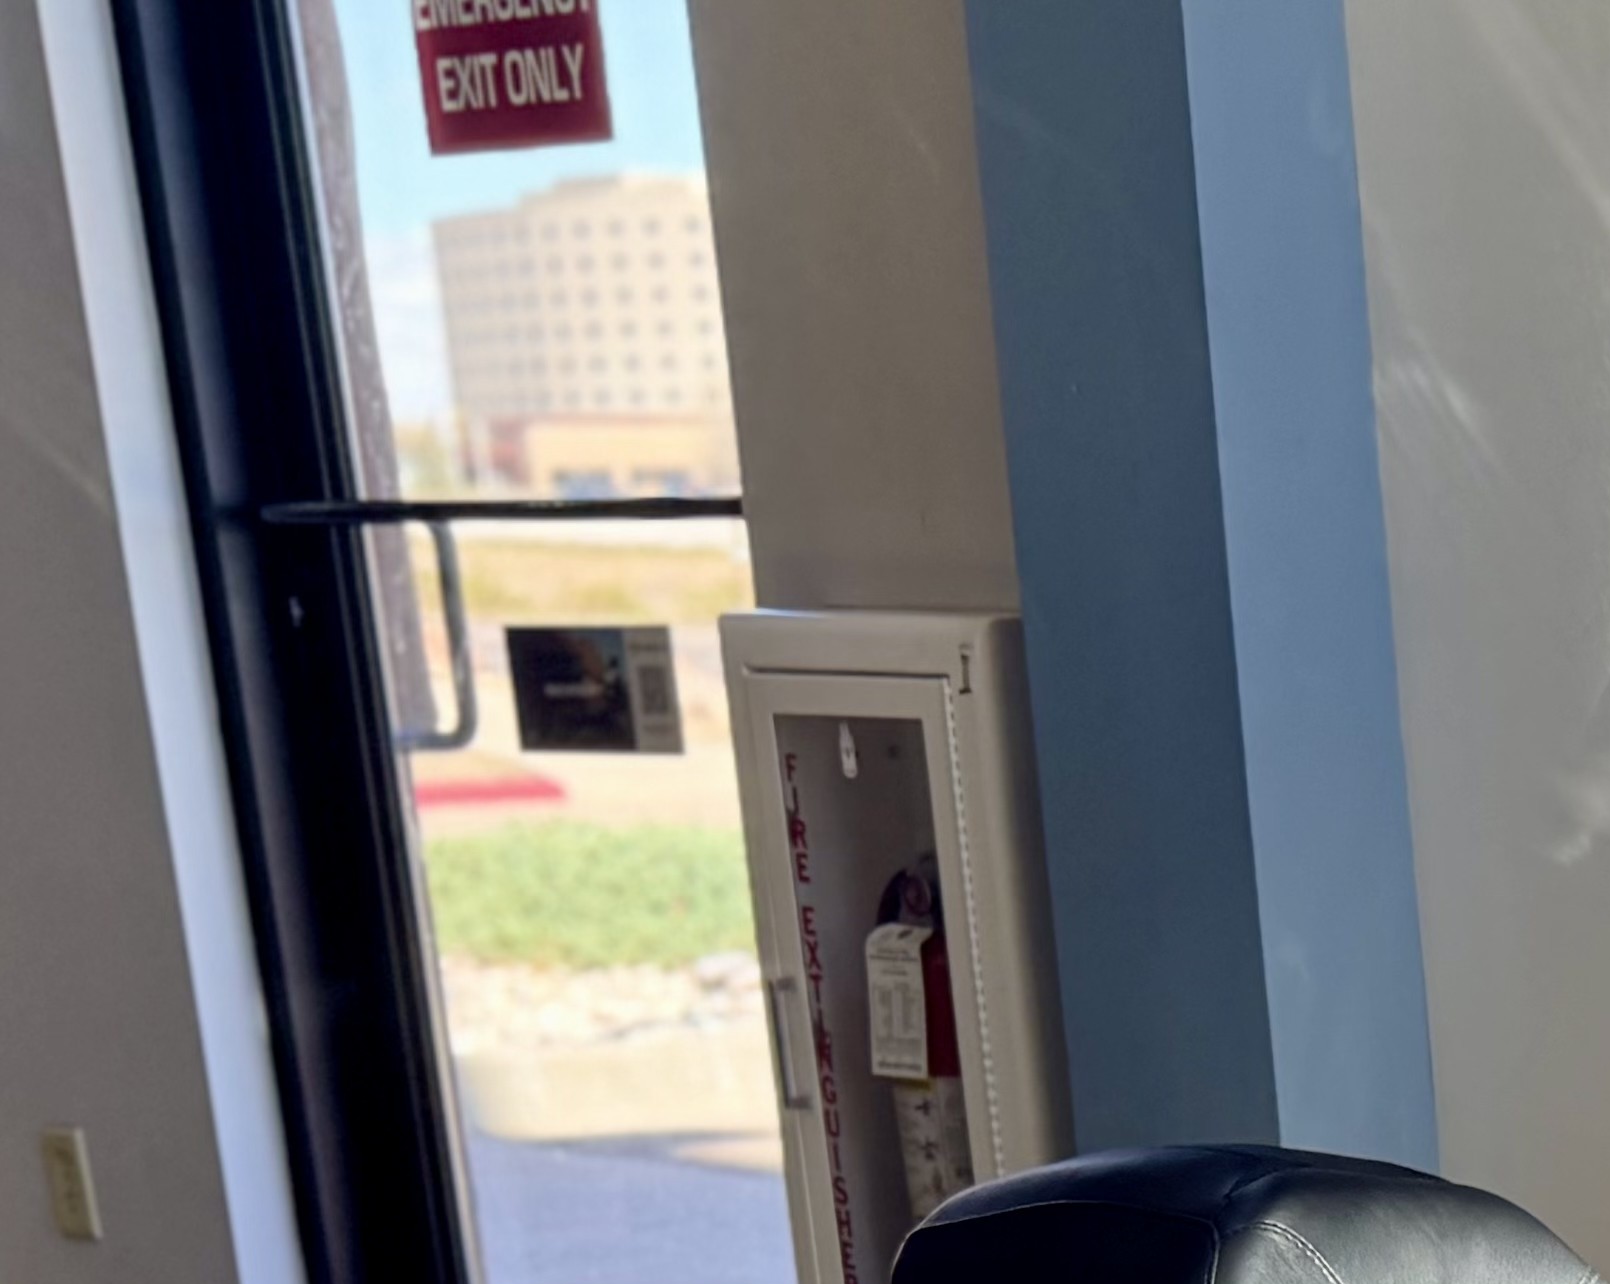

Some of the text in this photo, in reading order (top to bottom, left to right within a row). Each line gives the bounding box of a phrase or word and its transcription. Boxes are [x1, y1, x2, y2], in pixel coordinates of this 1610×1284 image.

[436, 43, 585, 114] EXIT ONLY
[785, 752, 811, 884] FIRE
